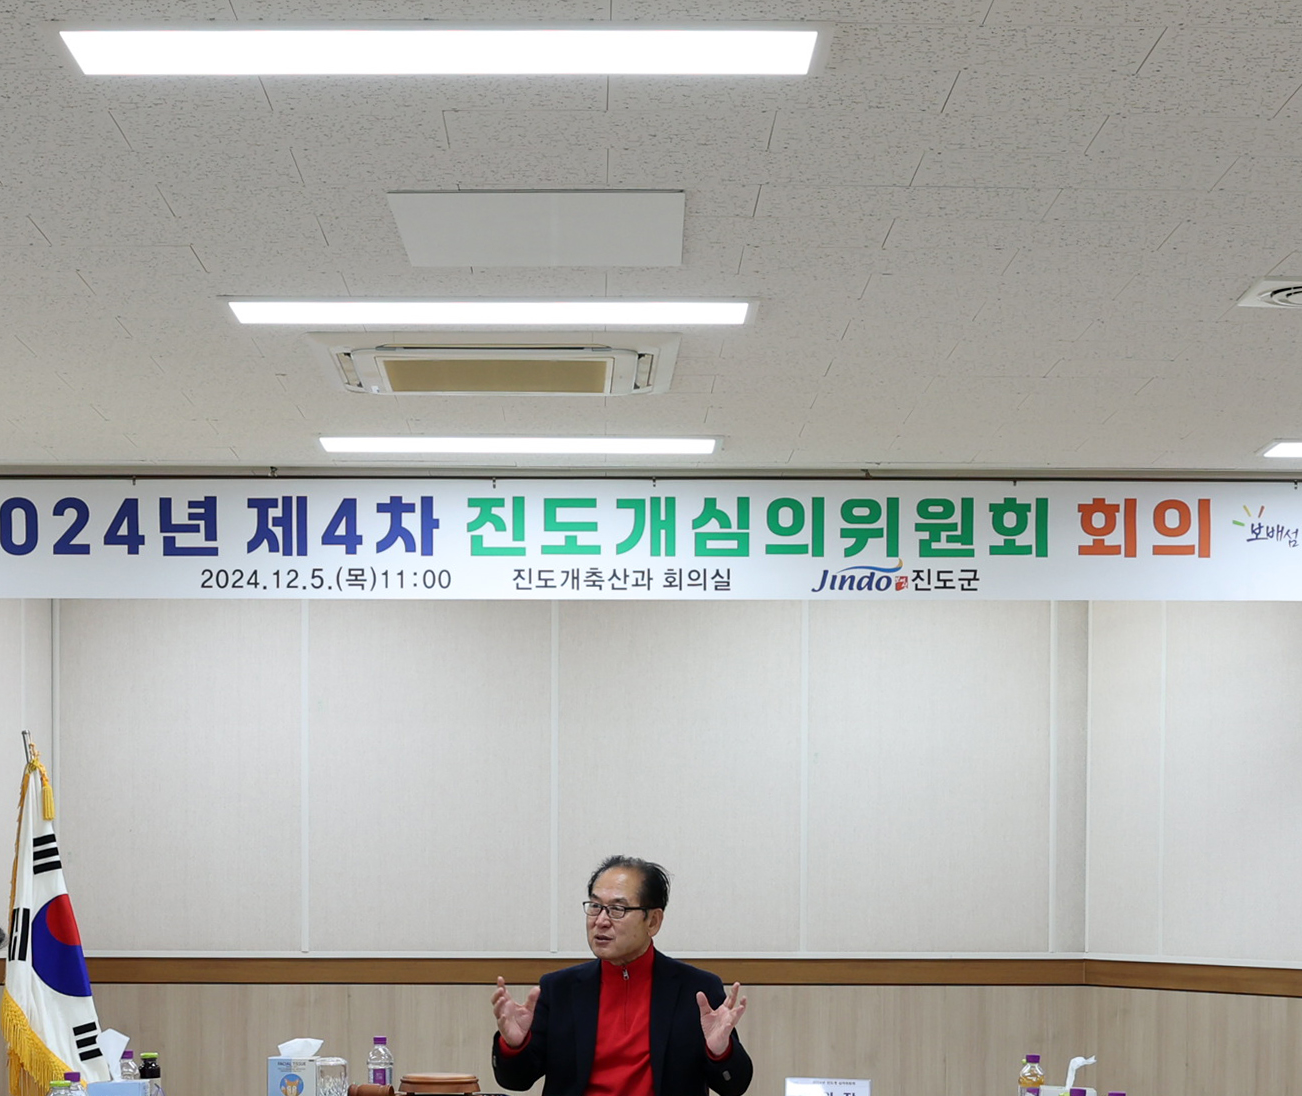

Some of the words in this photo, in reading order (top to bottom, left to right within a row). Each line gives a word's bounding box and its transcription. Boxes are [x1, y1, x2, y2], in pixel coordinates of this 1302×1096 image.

[246, 495, 441, 558] 제4차
[464, 495, 1049, 559] 진도개심의위원회
[1077, 497, 1212, 559] 회의
[1246, 523, 1299, 547] 보배섬
[512, 567, 654, 592] 진도개축산과
[662, 567, 732, 592] 회의실
[811, 568, 893, 593] Jindo
[911, 568, 981, 592] 진도군
